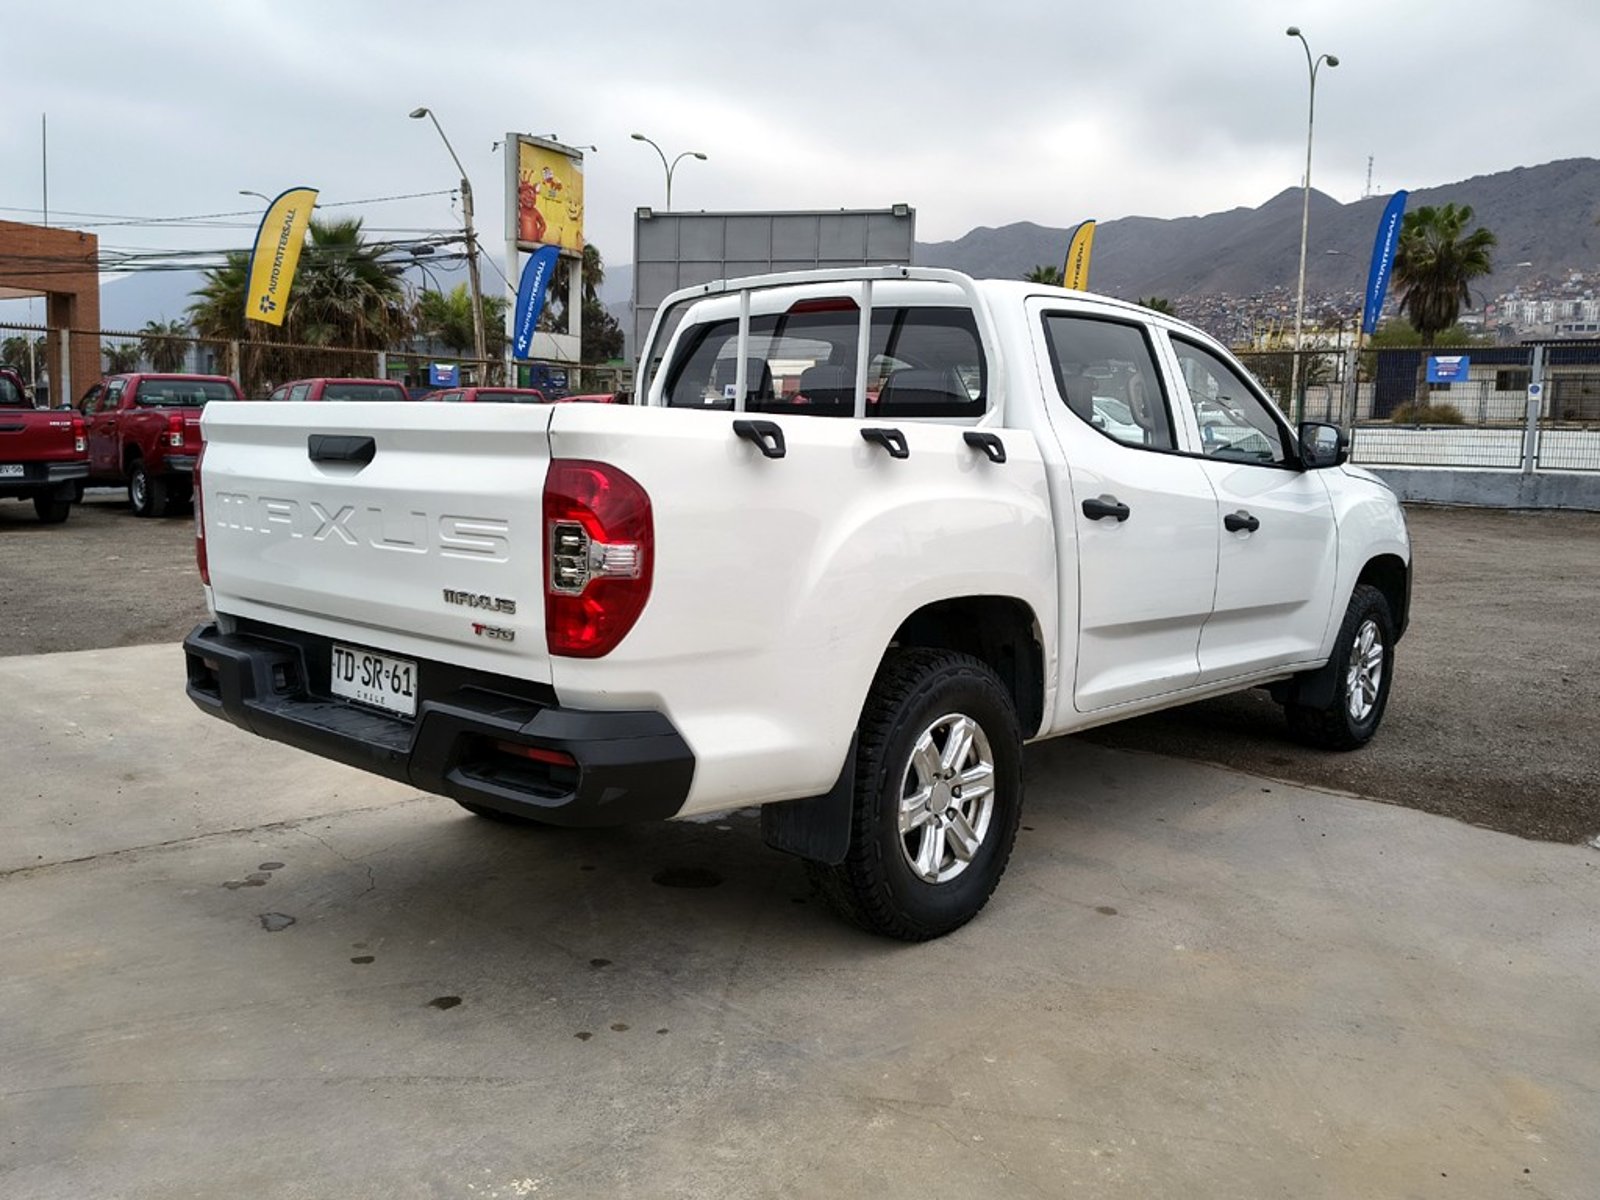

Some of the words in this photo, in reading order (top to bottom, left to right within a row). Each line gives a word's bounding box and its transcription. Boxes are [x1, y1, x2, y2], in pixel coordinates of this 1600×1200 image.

[268, 207, 296, 295] AUTOTATTERSALL
[522, 260, 546, 335] AUTOTATTERSALL
[215, 491, 510, 564] MAXUS
[442, 588, 517, 615] MAXUS
[356, 689, 386, 705] CHILE
